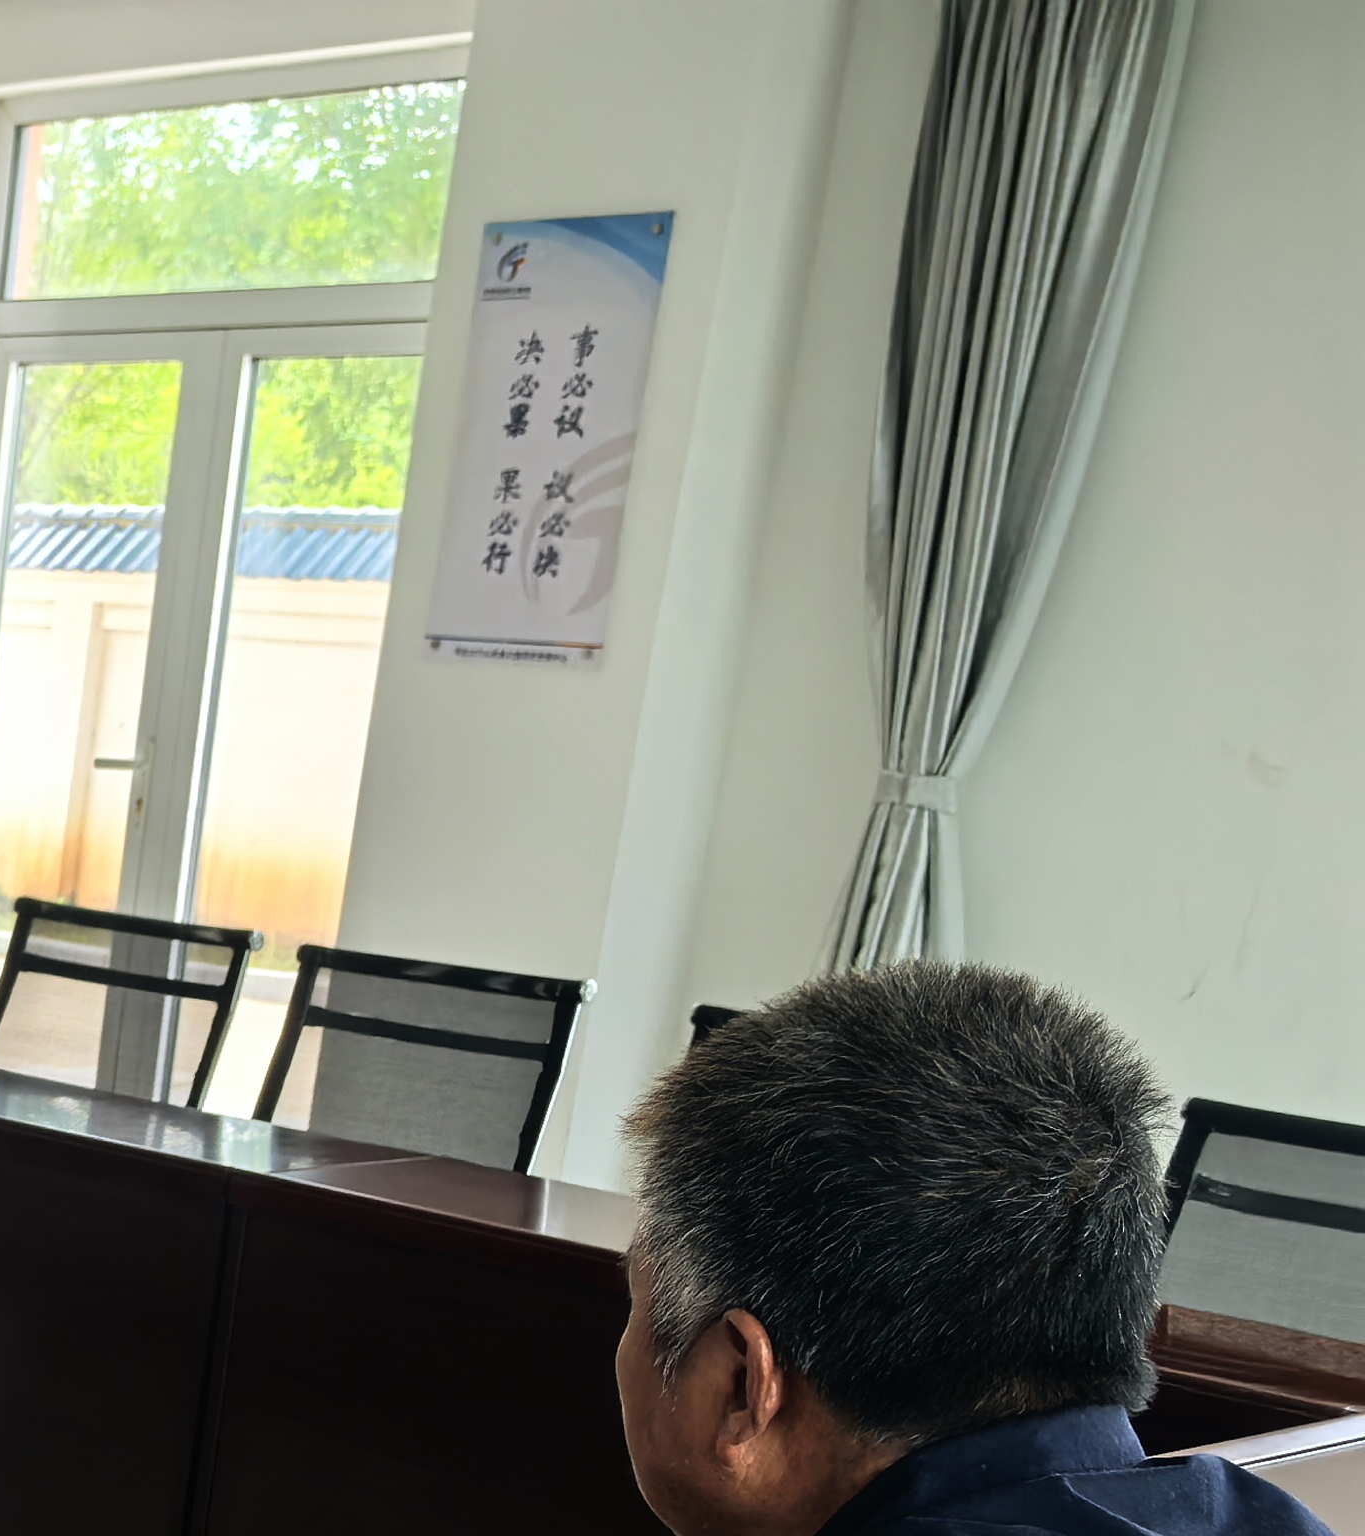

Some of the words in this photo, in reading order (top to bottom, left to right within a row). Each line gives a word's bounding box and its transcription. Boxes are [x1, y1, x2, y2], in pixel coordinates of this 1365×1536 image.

[552, 322, 598, 439] 事必议
[481, 467, 521, 574] 果必行
